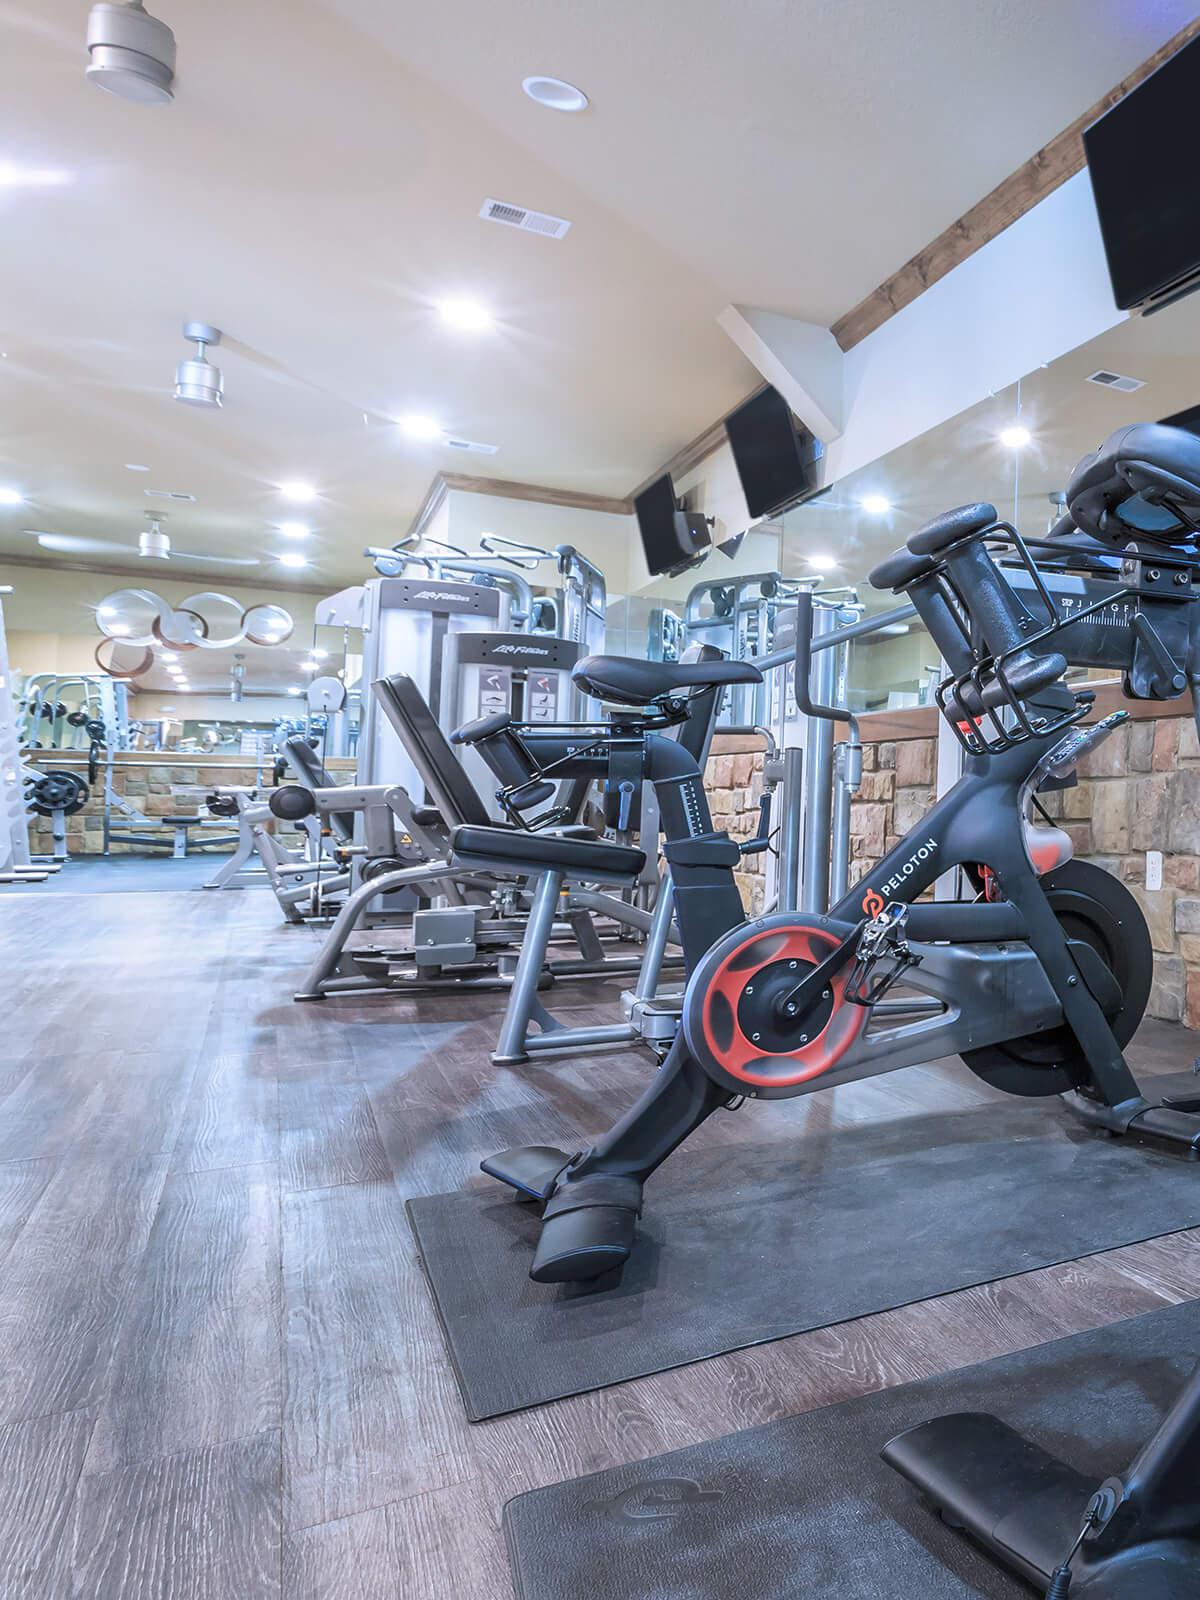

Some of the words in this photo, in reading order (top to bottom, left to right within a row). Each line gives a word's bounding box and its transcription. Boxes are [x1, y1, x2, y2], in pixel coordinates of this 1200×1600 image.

[1111, 603, 1119, 611] G
[1124, 604, 1129, 612] F
[881, 838, 938, 896] PELOTON
